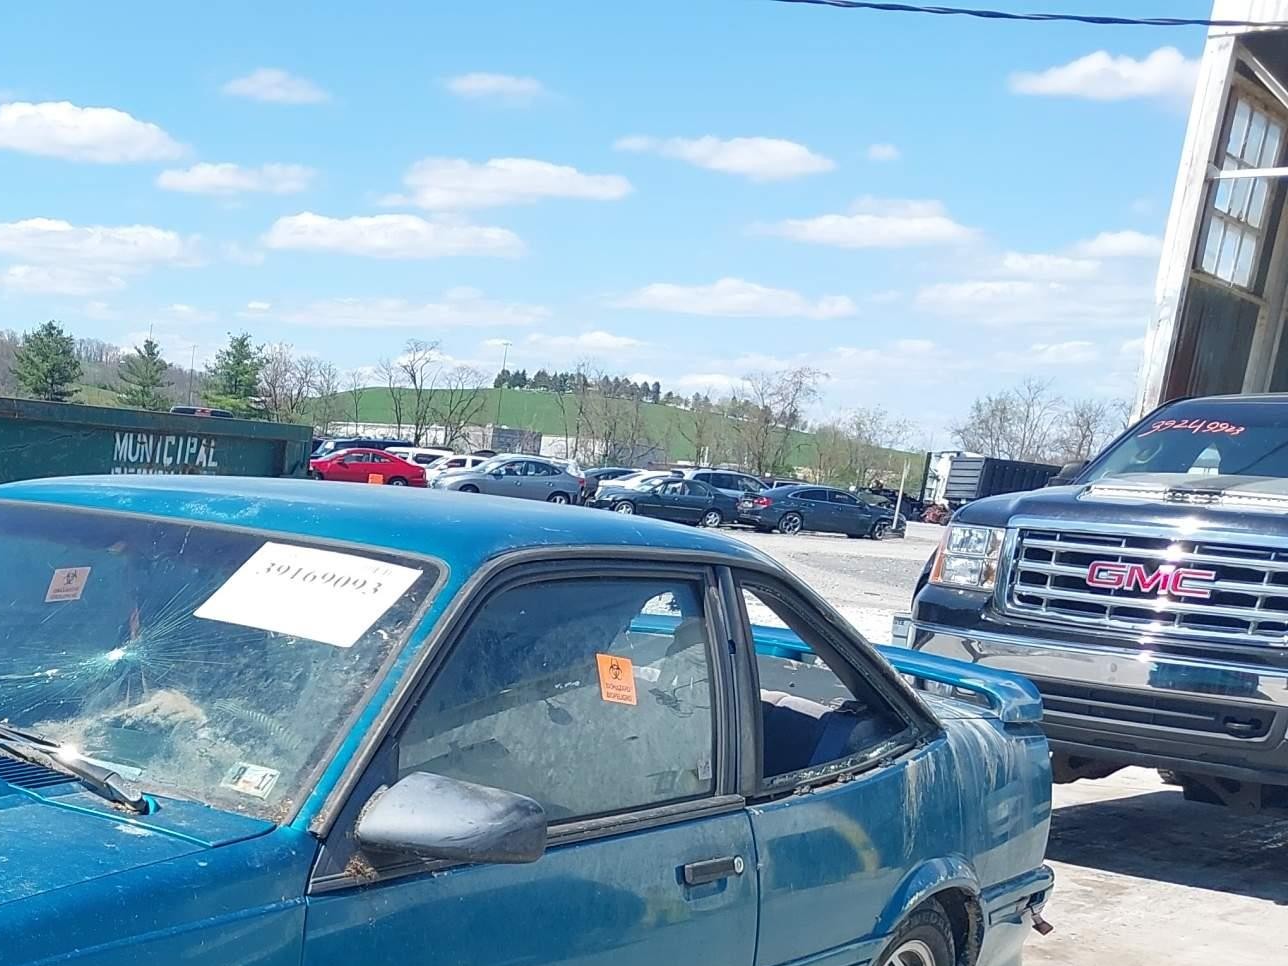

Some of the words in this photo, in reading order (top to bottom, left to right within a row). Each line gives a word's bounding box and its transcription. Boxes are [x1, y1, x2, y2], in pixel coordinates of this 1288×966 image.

[113, 432, 218, 468] MUNICIPAL
[257, 562, 384, 595] 39169093
[1086, 560, 1217, 599] GMC
